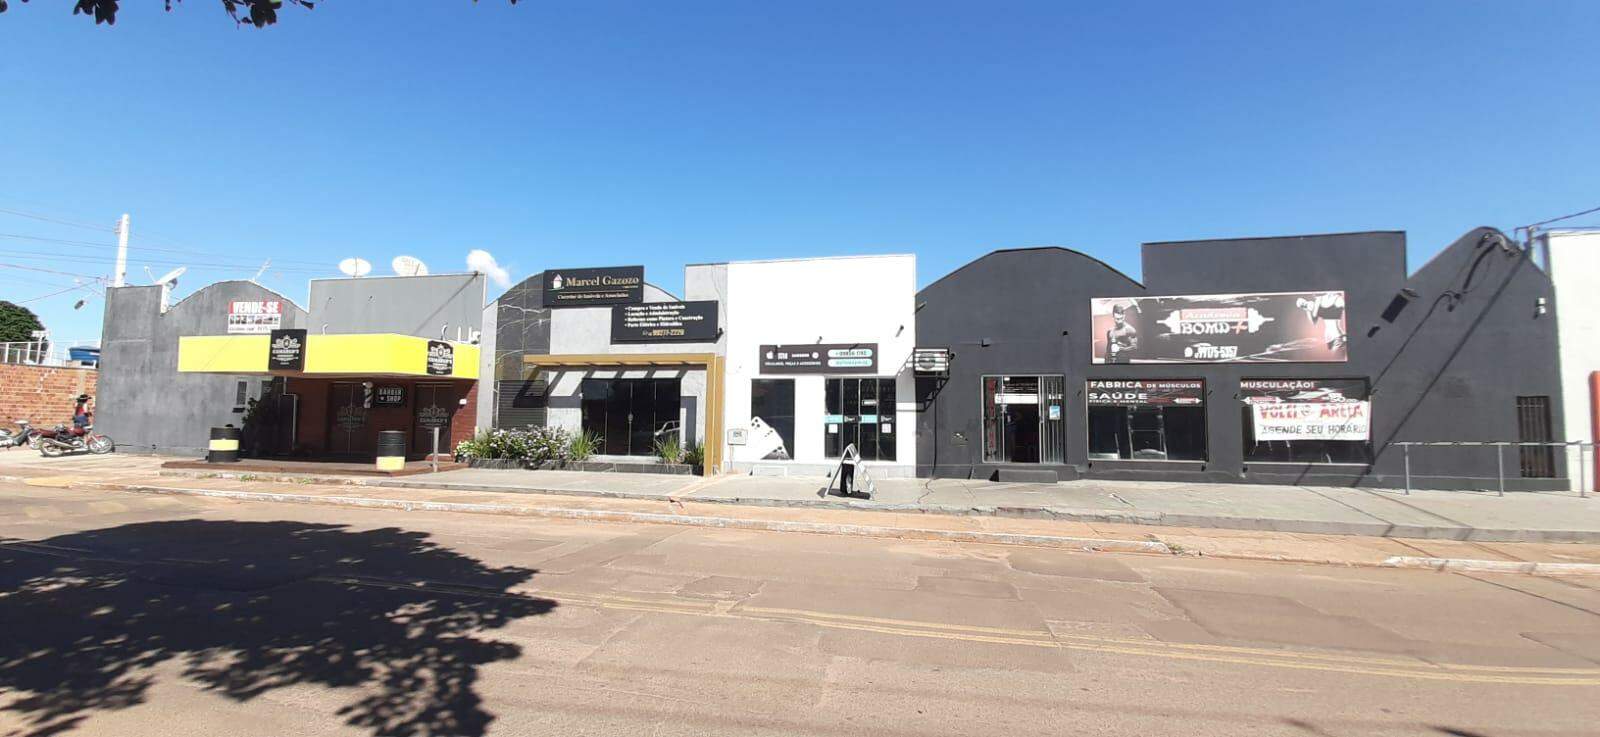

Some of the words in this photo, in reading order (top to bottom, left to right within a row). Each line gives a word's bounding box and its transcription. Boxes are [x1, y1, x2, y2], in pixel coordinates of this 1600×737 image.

[566, 276, 600, 287] Marcel
[602, 275, 639, 286] Gazozo
[233, 301, 279, 314] VENDE-SE
[1240, 380, 1314, 389] MUSCULAÇÃO!
[1088, 391, 1148, 400] SAÚDE
[1261, 425, 1303, 434] AGENDE
[1305, 424, 1323, 434] SEU
